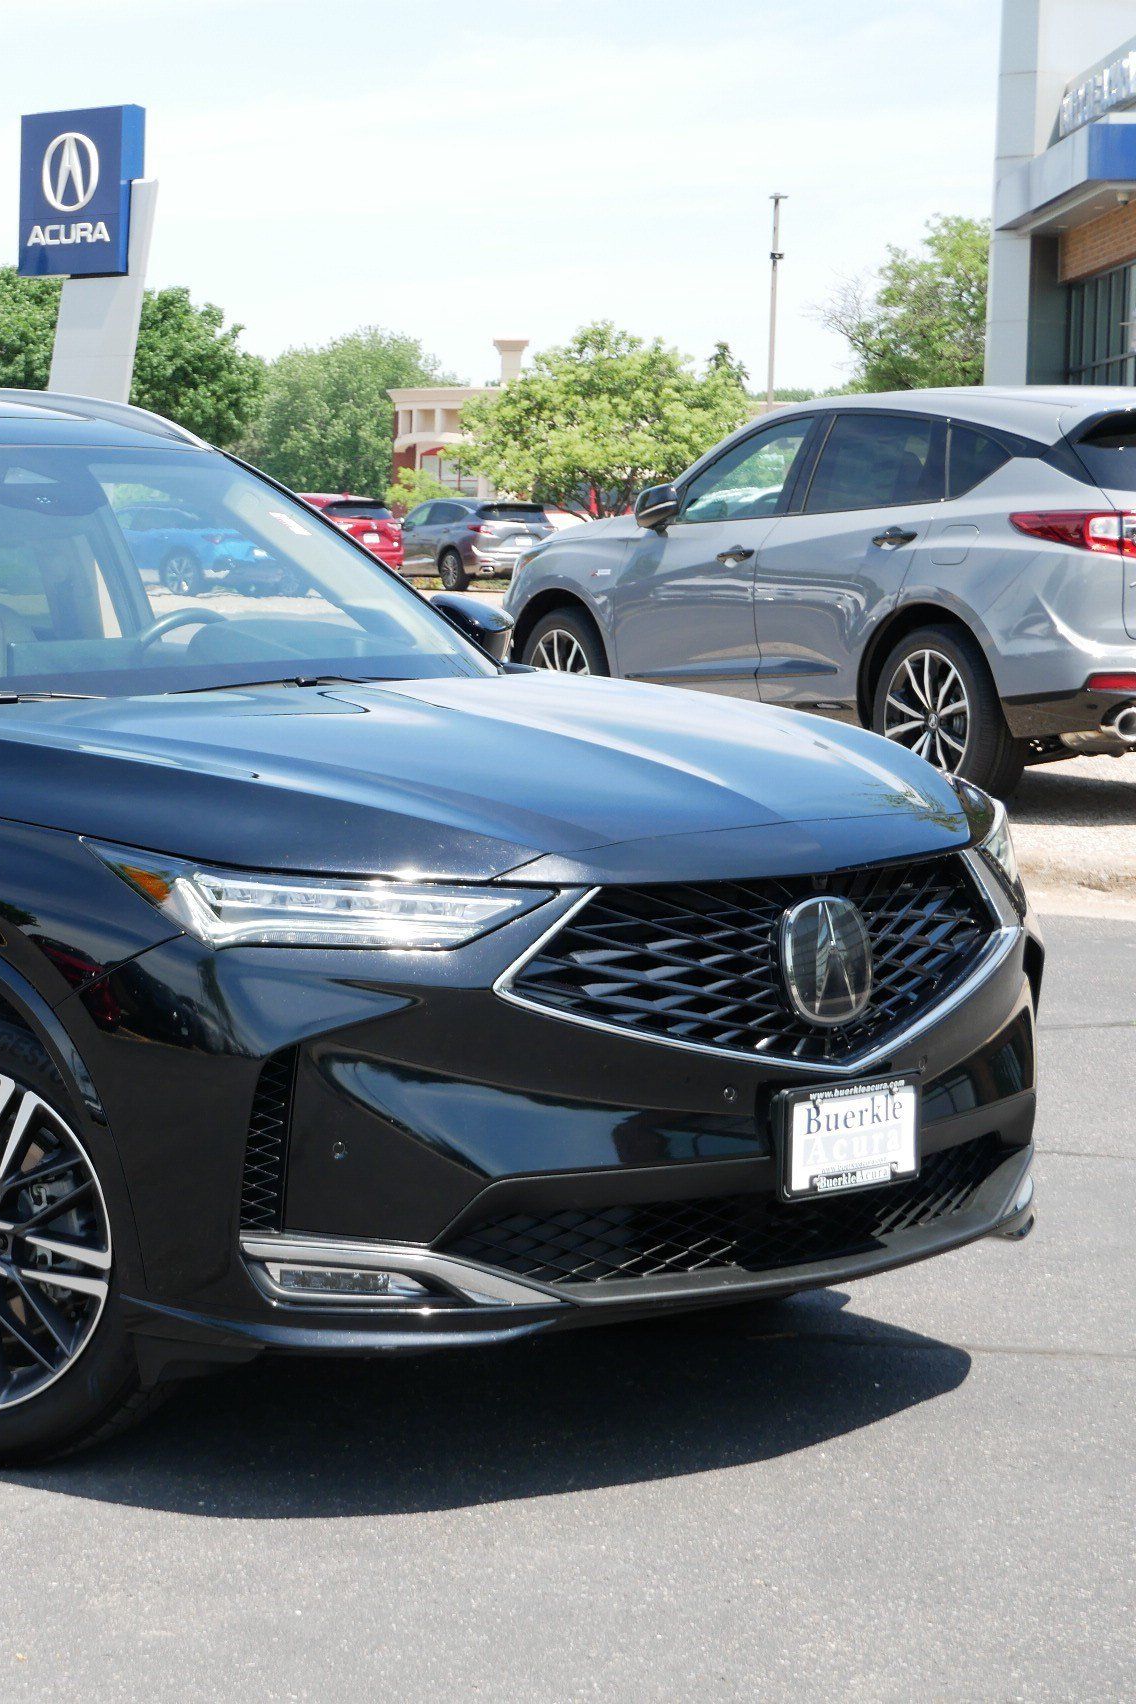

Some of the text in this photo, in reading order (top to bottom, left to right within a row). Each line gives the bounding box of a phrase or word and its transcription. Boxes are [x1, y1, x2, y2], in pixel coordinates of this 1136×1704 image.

[27, 221, 111, 247] ACURA
[804, 1093, 904, 1135] Buerkle
[806, 1127, 902, 1165] Acura
